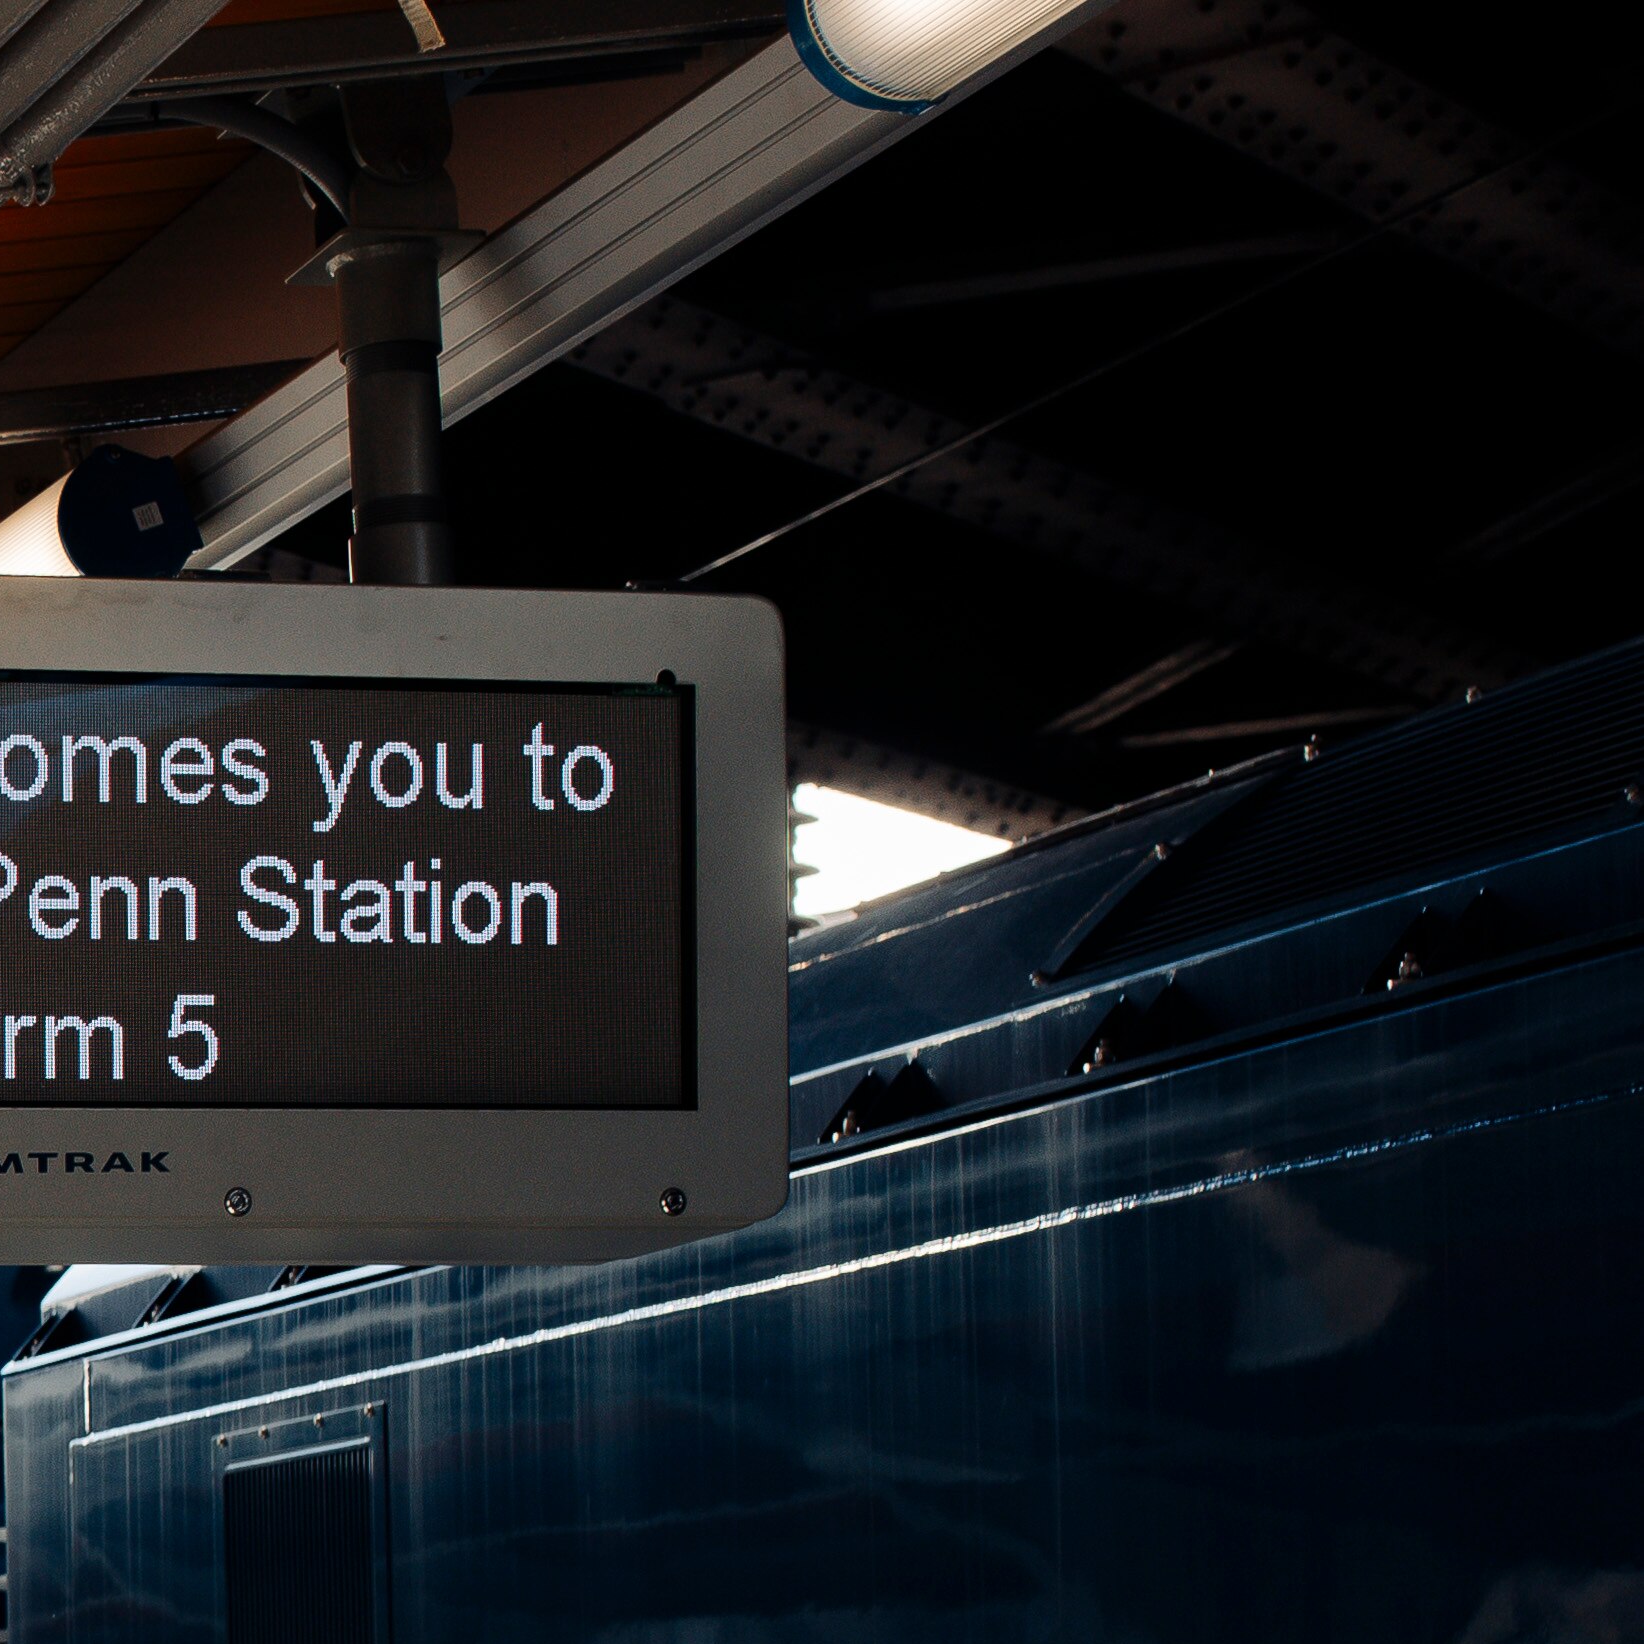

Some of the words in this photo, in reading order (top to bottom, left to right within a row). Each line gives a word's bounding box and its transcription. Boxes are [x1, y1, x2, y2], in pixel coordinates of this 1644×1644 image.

[311, 741, 482, 832] you
[524, 724, 613, 810] to
[238, 856, 557, 944] Station
[168, 995, 218, 1080] 5
